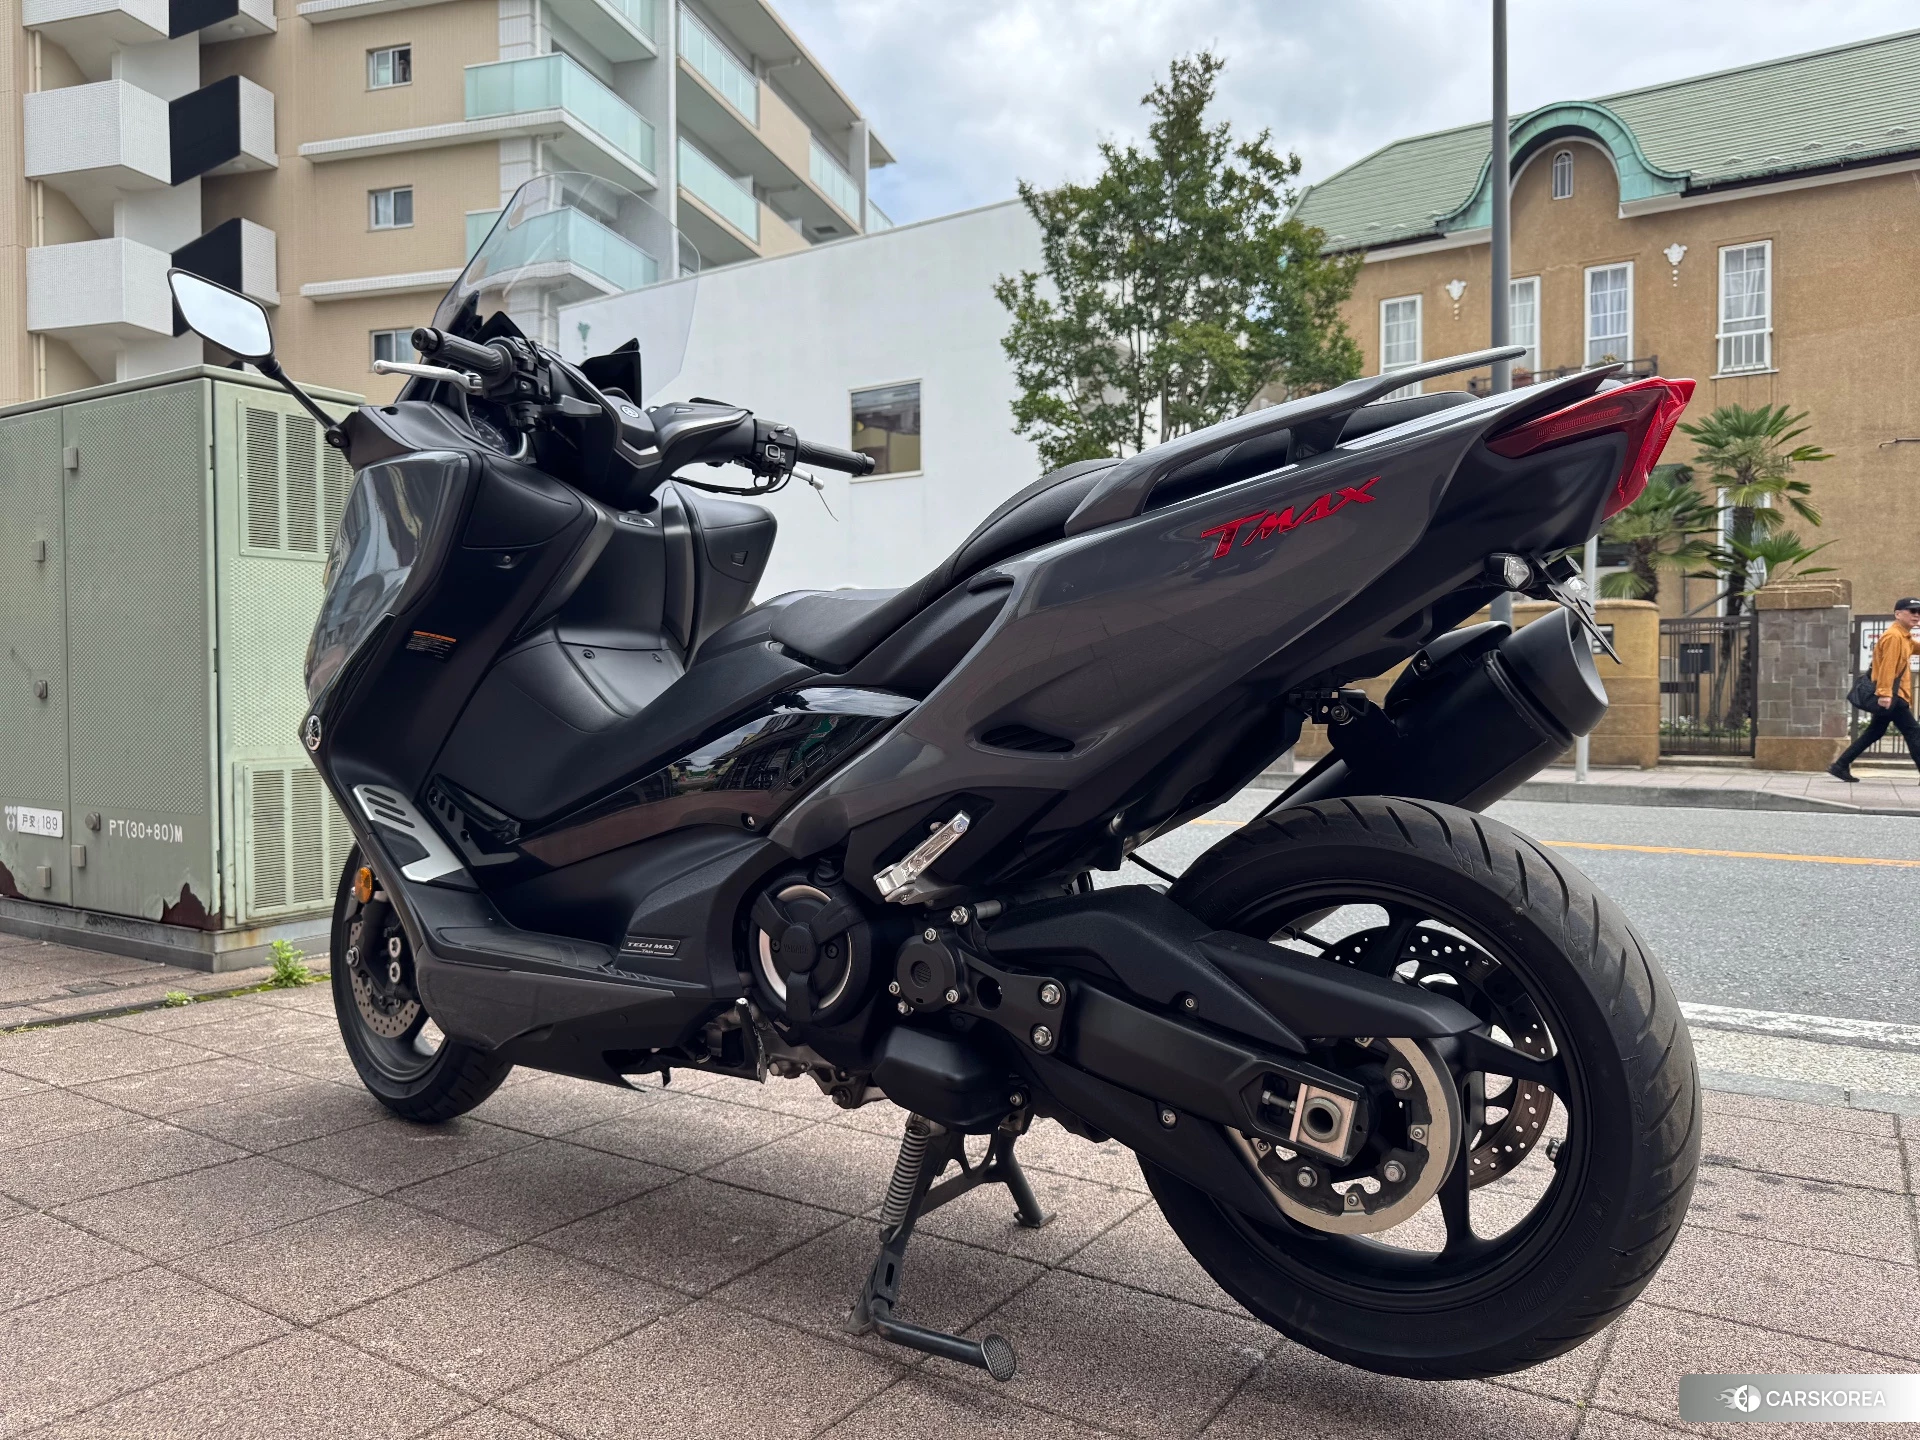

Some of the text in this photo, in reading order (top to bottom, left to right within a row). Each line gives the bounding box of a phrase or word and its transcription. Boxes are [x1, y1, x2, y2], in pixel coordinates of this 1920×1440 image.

[1200, 475, 1382, 559] TMAX
[42, 815, 58, 831] 189
[109, 819, 183, 843] PT(30+80)M
